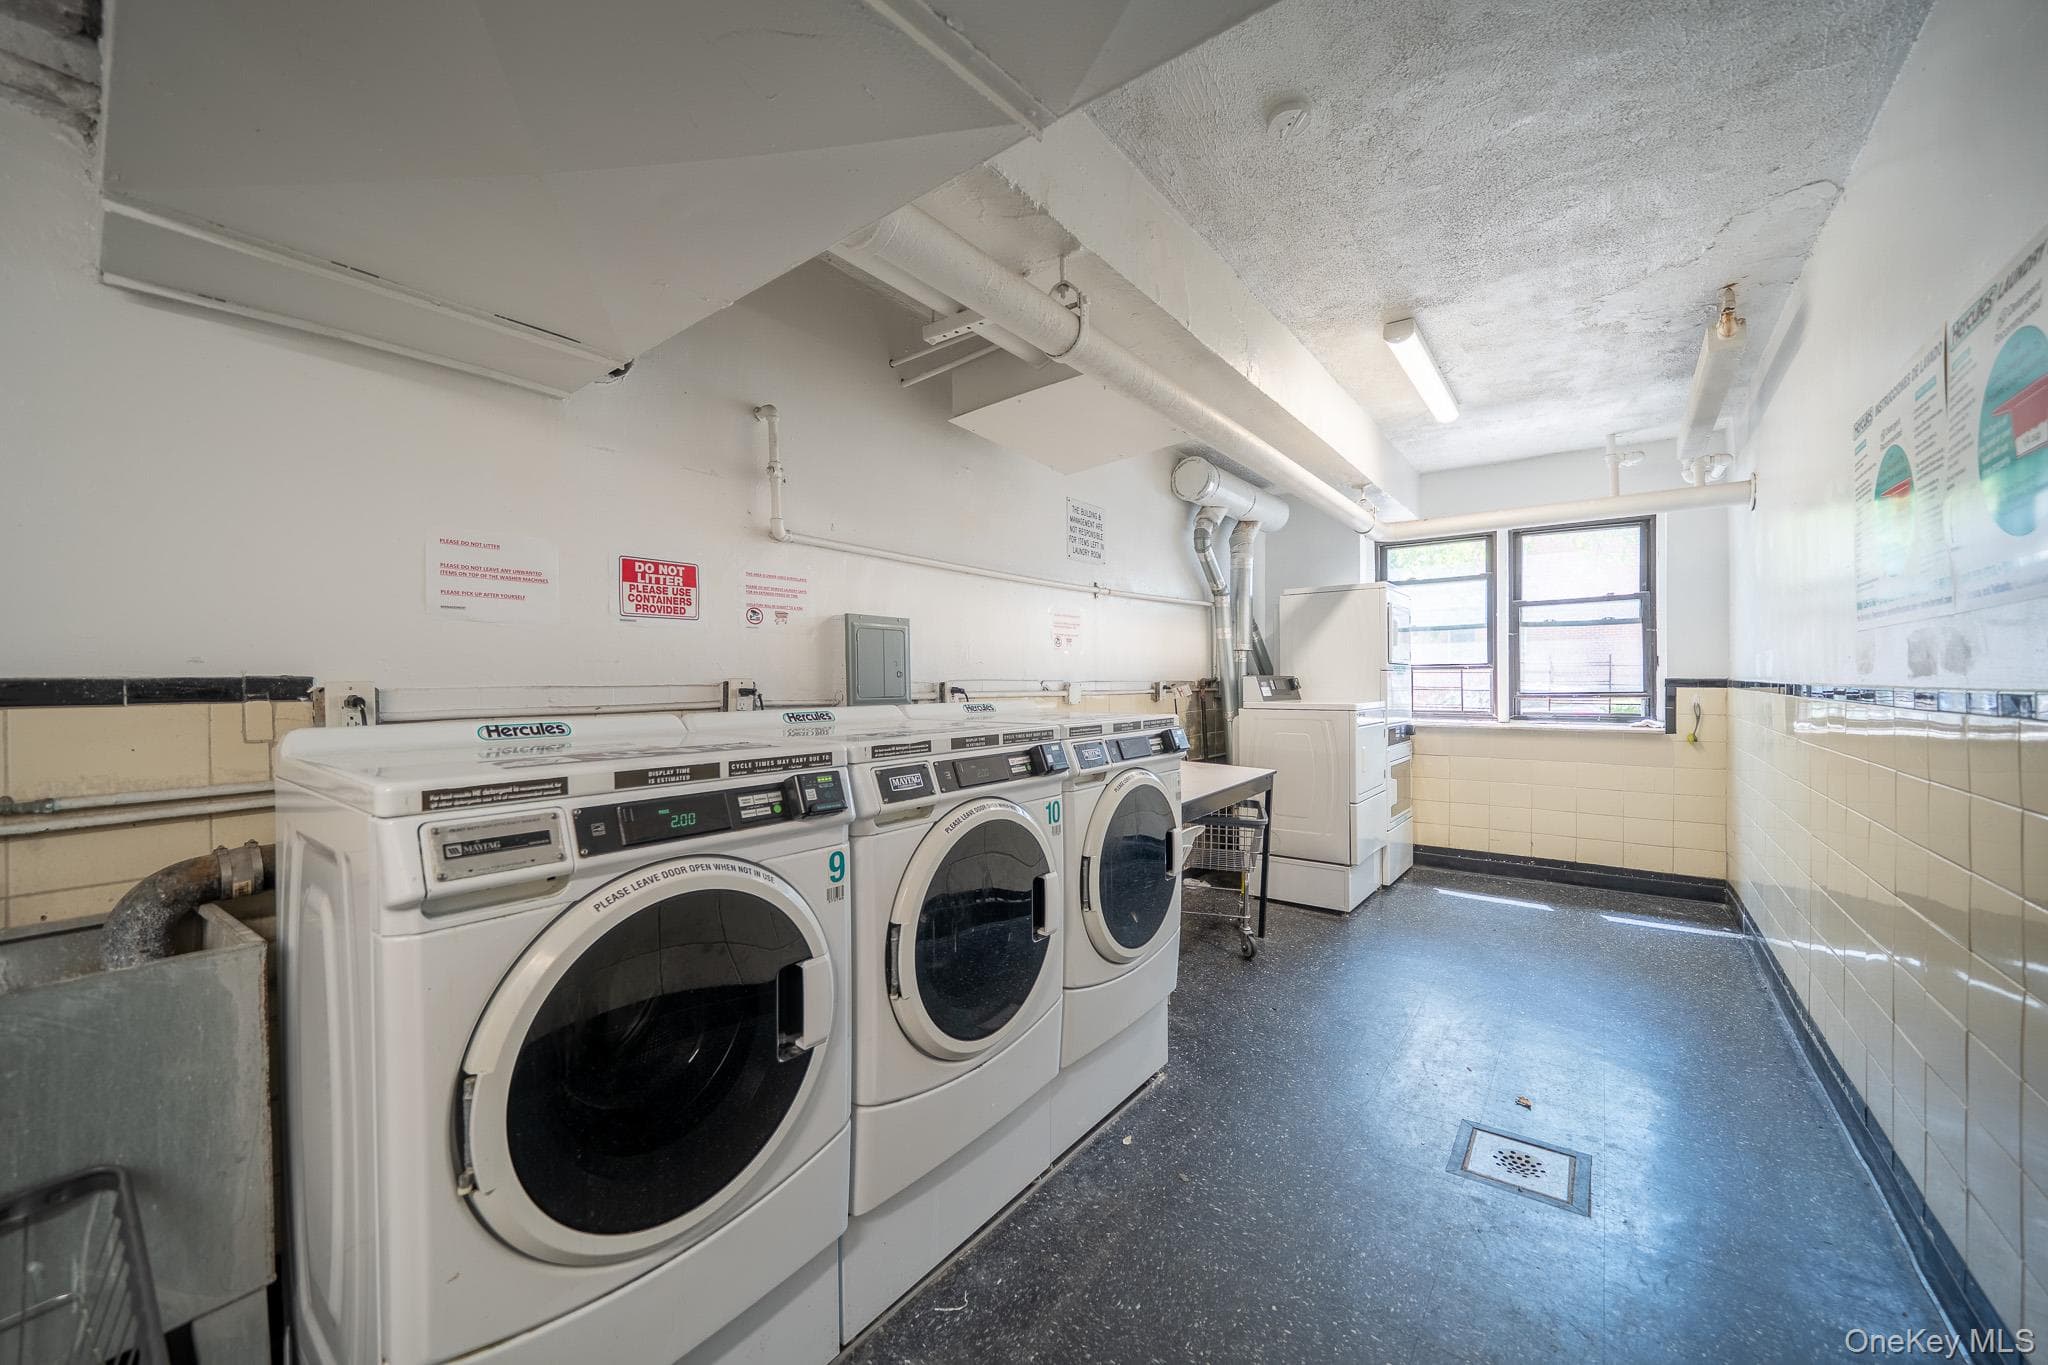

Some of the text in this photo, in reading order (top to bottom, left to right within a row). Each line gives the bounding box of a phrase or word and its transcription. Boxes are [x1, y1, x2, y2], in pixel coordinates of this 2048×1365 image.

[635, 562, 684, 576] DO NOT
[638, 573, 684, 586] LITTER
[629, 584, 691, 596] PLEASE USE
[628, 594, 692, 606] CONTAINERS
[635, 604, 686, 615] PROVIDED
[786, 712, 832, 722] Hercules
[486, 723, 566, 738] Hercules
[657, 775, 690, 784] ESTIMATED
[892, 775, 920, 786] MAYTAG
[1045, 800, 1060, 824] 10
[671, 813, 696, 827] 2.00
[944, 817, 962, 834] PLEASE
[960, 810, 975, 820] LEAVE
[463, 841, 500, 853] MAYTAG
[829, 851, 845, 882] 9
[593, 886, 631, 913] PLEASE
[630, 872, 661, 892] LEAVE
[662, 866, 688, 879] DOOR
[689, 863, 712, 872] OPEN
[713, 863, 737, 872] WHEN
[738, 866, 752, 875] NOT
[762, 872, 776, 884] USE
